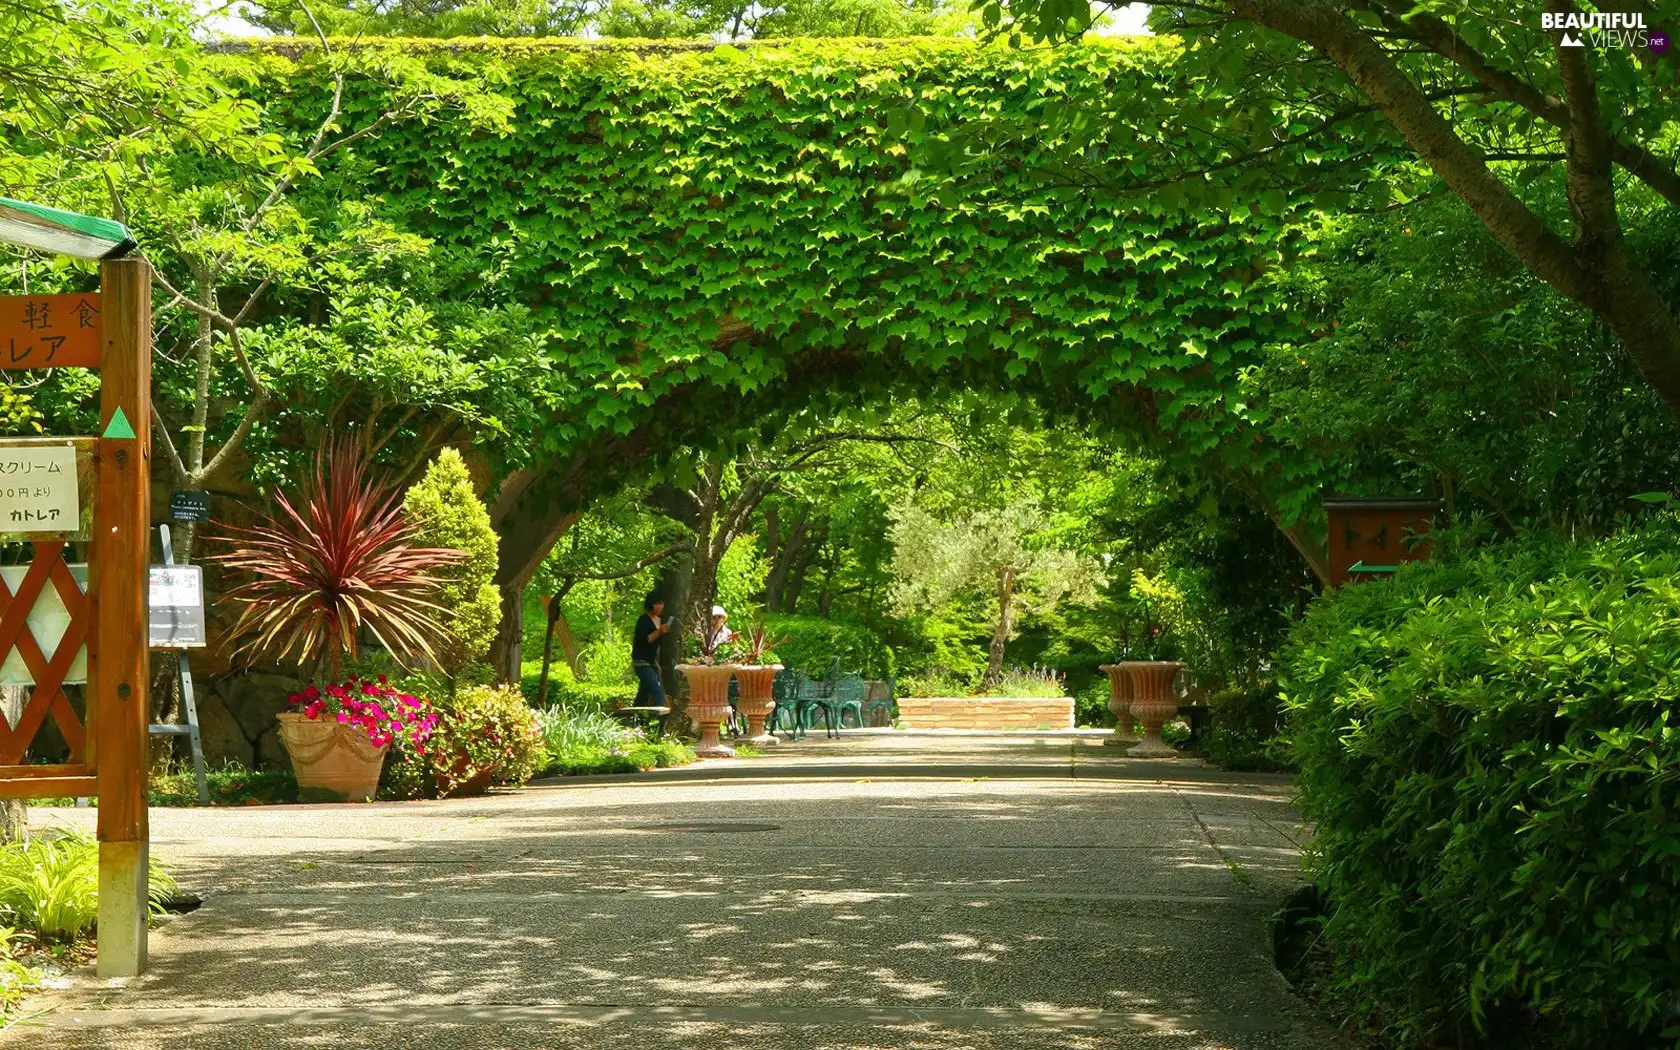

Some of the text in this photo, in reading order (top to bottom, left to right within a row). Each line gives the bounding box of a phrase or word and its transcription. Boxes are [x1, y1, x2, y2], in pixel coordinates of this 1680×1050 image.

[0, 335, 67, 363] レア
[10, 508, 60, 521] カトレア
